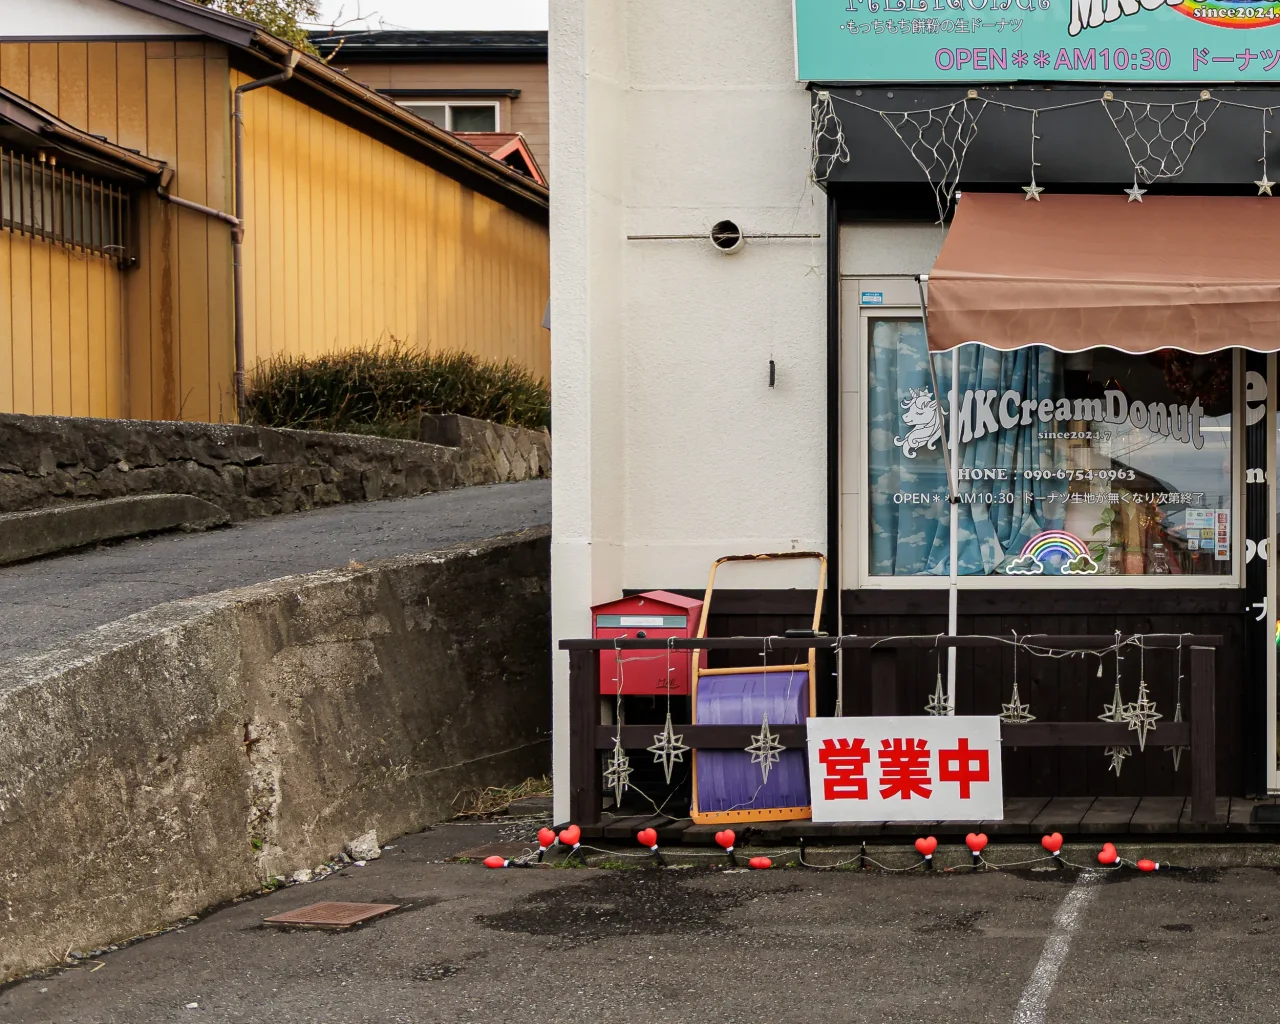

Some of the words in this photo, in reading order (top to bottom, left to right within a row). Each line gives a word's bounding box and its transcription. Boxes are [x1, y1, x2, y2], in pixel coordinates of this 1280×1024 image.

[957, 468, 1008, 480] HONE
[818, 737, 990, 801] 営業中
